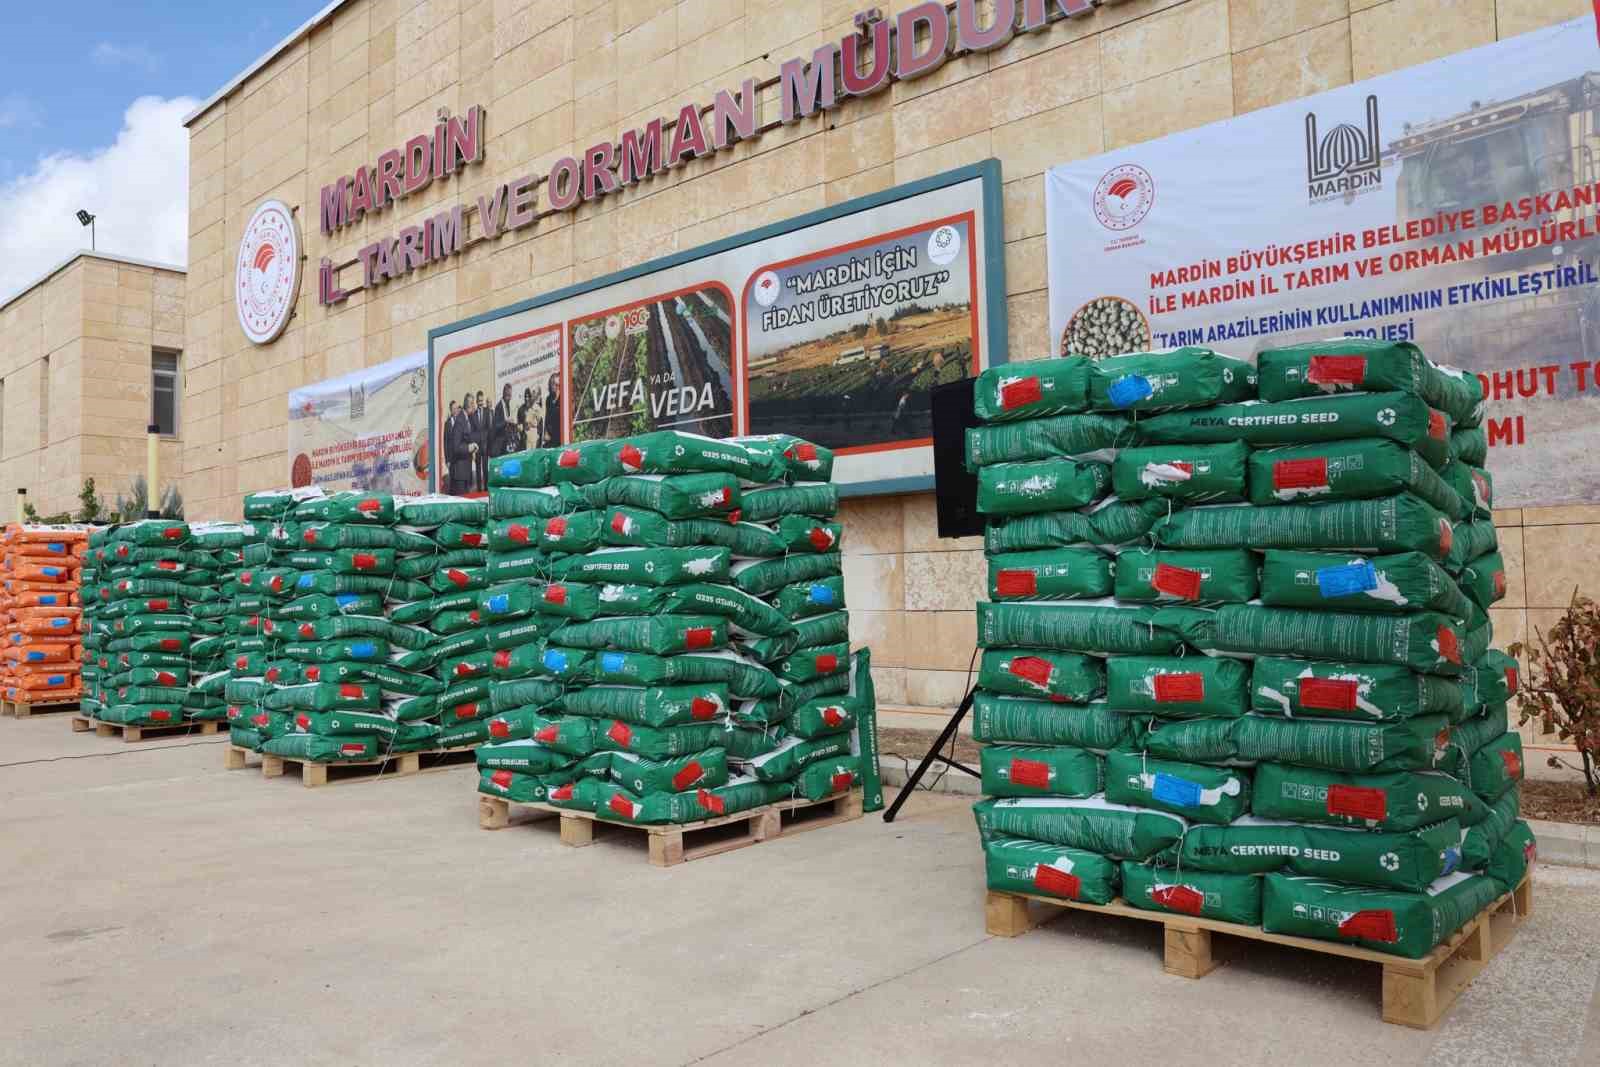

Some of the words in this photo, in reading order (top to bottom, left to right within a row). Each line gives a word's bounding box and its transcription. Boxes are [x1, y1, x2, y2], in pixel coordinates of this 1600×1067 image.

[319, 256, 346, 304] İL
[358, 203, 464, 289] TARIM
[477, 174, 539, 240] VE
[548, 77, 758, 210] ORMAN
[320, 104, 480, 236] MARDİN
[786, 256, 871, 296] “MARDİN
[874, 245, 917, 280] İÇİN
[1150, 258, 1221, 289] MARDİN
[1227, 231, 1356, 274] BÜYÜKŞEHİR
[1362, 209, 1475, 248] BELEDİYE
[762, 302, 814, 332] FİDAN
[818, 270, 950, 320] ÜRETİYORUZ”
[1149, 295, 1177, 315] İLE
[1181, 278, 1255, 308] MARDİN
[1261, 274, 1279, 295] İL
[1284, 262, 1349, 290] TARIM
[1355, 256, 1383, 278] VE
[1389, 240, 1474, 273] ORMAN
[1207, 308, 1312, 342] ARAZİLERİNİN
[1317, 288, 1442, 325] KULLANIMININ
[1448, 260, 1598, 305] ETKİNLEŞTİRİL
[592, 378, 645, 412] VEFA
[650, 374, 661, 385] YA
[650, 382, 715, 418] VEDA
[1228, 413, 1298, 427] CERTIFIED
[1301, 411, 1340, 424] SEED
[1230, 845, 1300, 857] CERTIFIED
[1303, 848, 1341, 862] SEED
